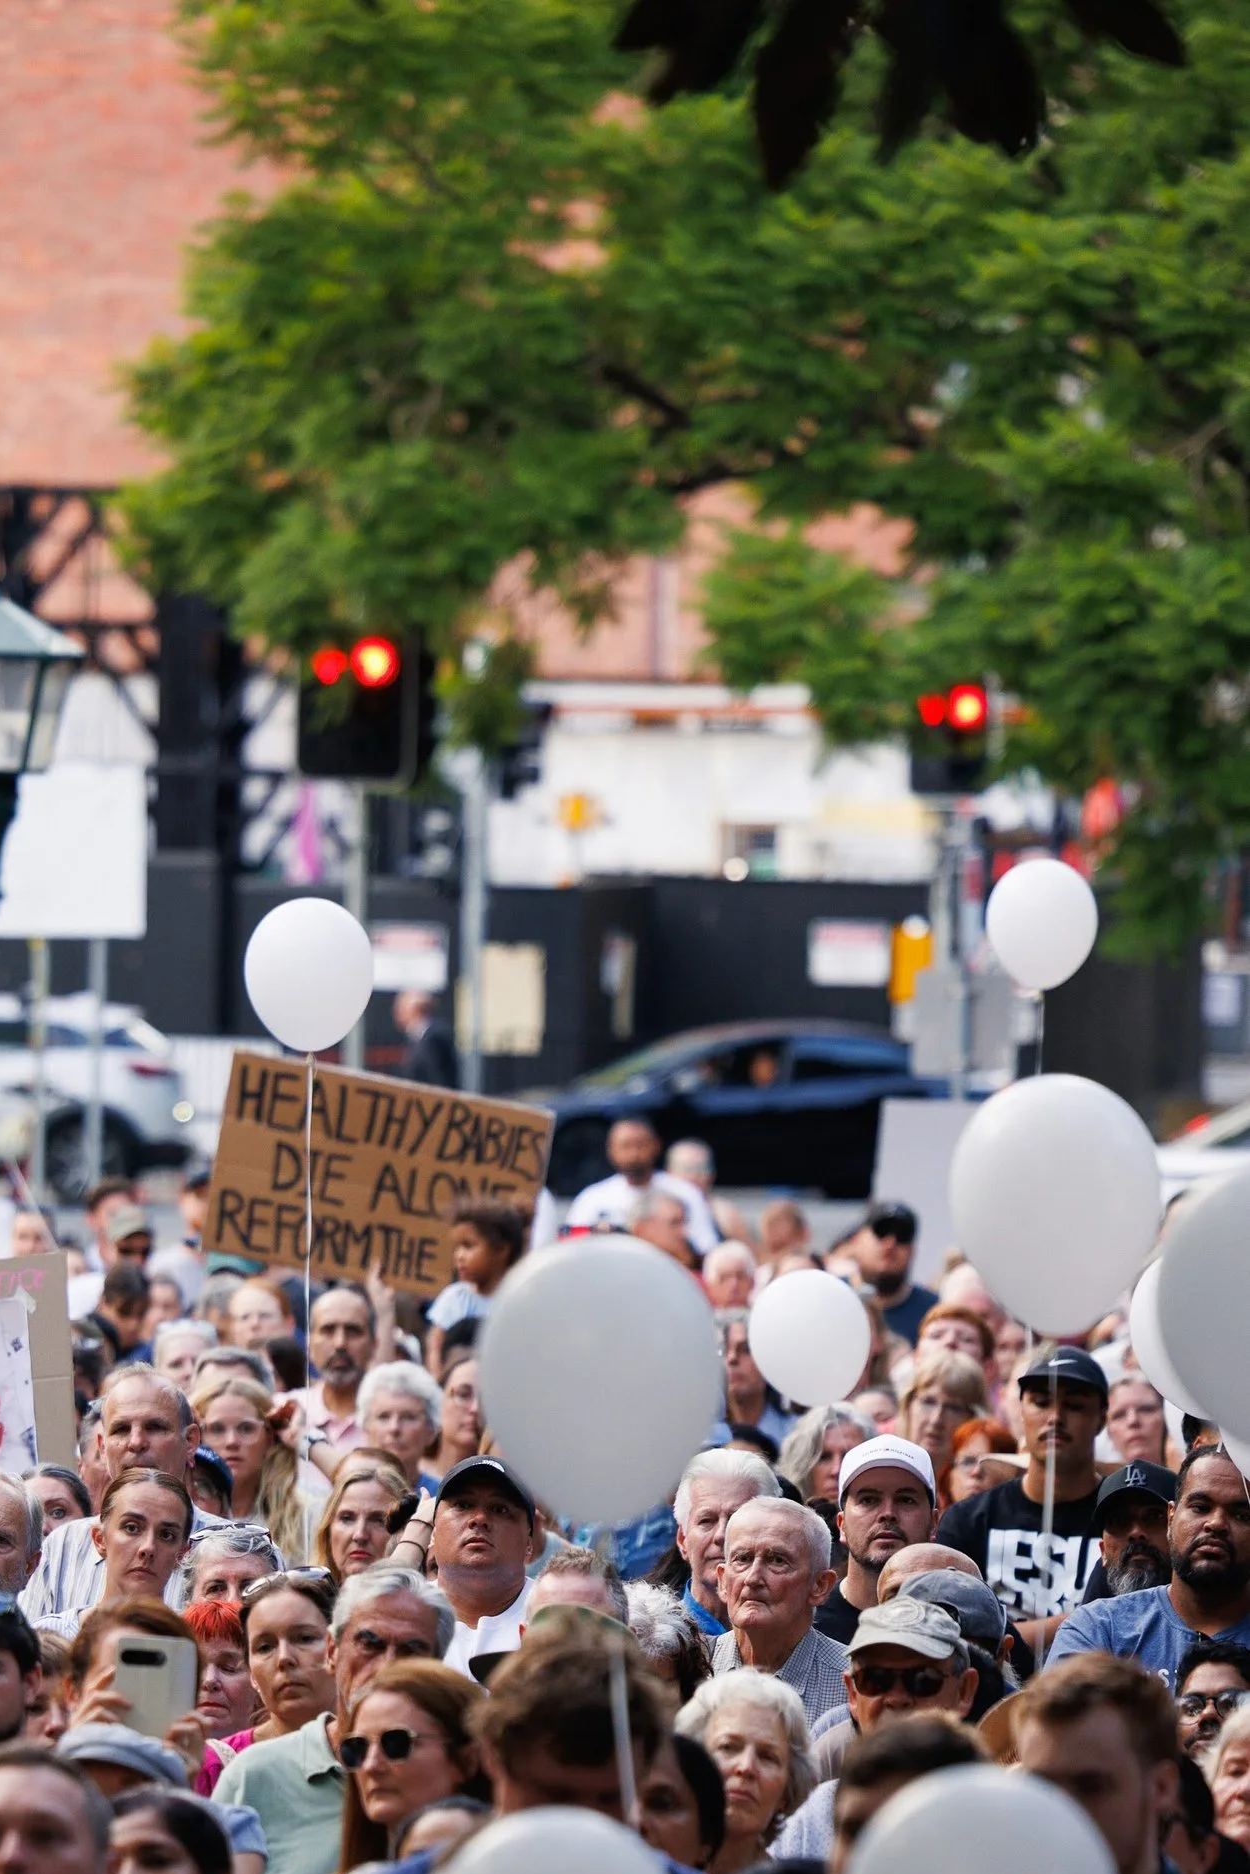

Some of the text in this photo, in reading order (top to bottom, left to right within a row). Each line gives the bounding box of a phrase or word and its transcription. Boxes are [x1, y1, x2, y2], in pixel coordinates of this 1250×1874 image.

[236, 1064, 545, 1181] HEALTHY BABIES
[271, 1141, 353, 1206] DIE
[215, 1188, 439, 1283] REFORM THE
[1125, 1464, 1146, 1487] LA
[987, 1528, 1103, 1598] JESU
